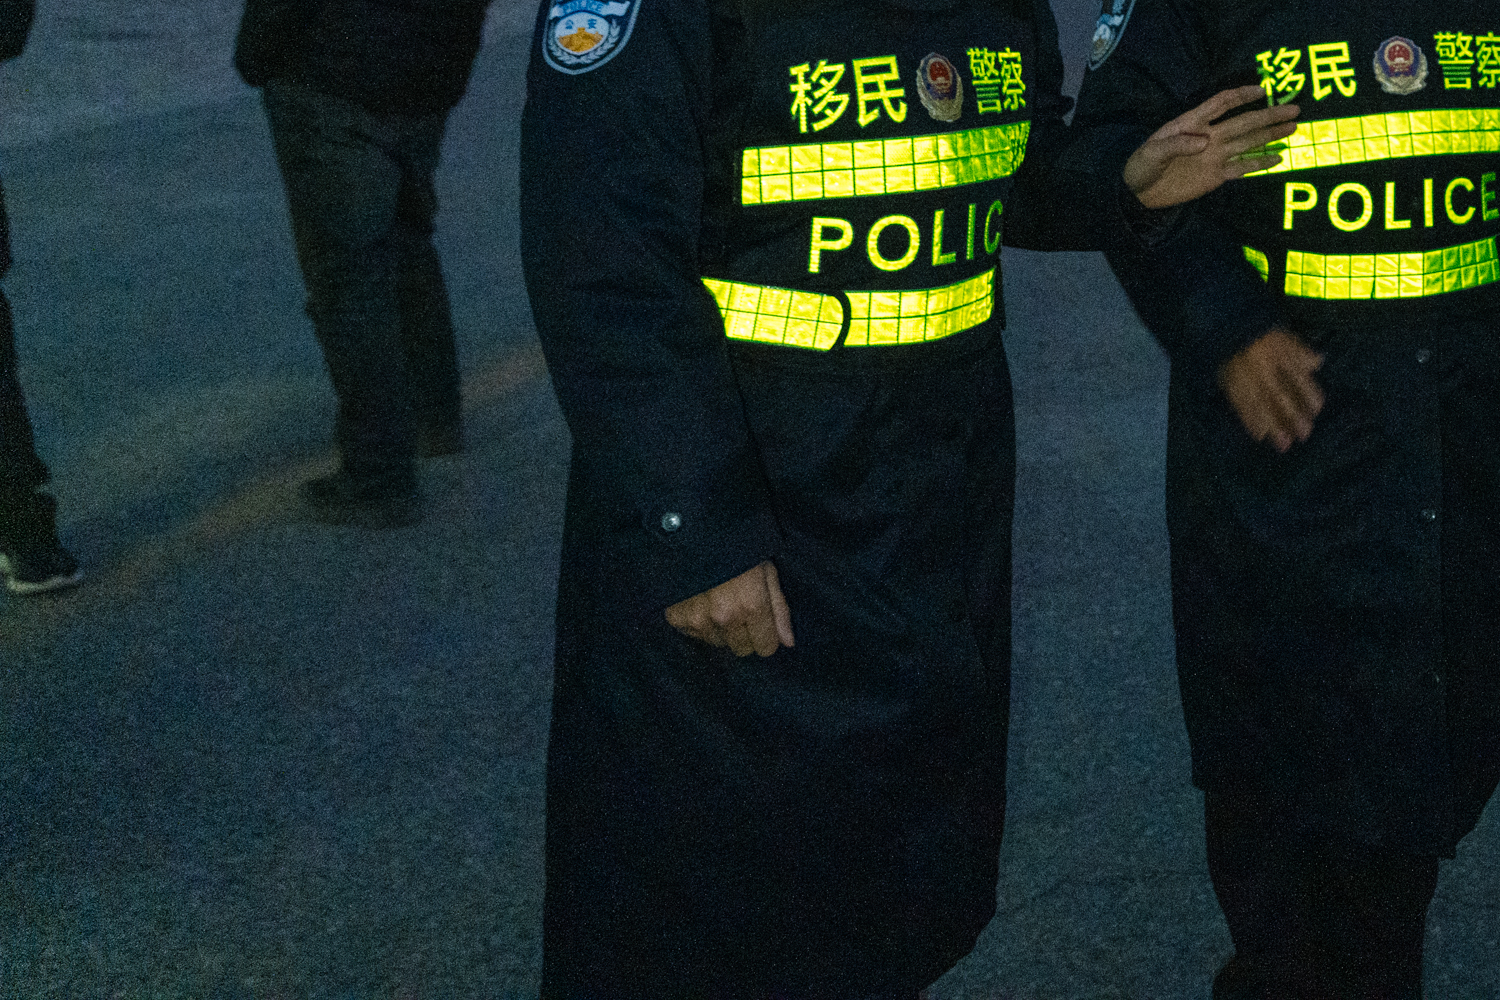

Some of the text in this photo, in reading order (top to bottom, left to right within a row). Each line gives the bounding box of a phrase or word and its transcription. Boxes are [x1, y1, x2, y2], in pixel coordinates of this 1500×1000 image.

[789, 46, 1027, 133] 移民 警察
[1255, 41, 1358, 107] 移民
[1282, 171, 1500, 232] POLICE
